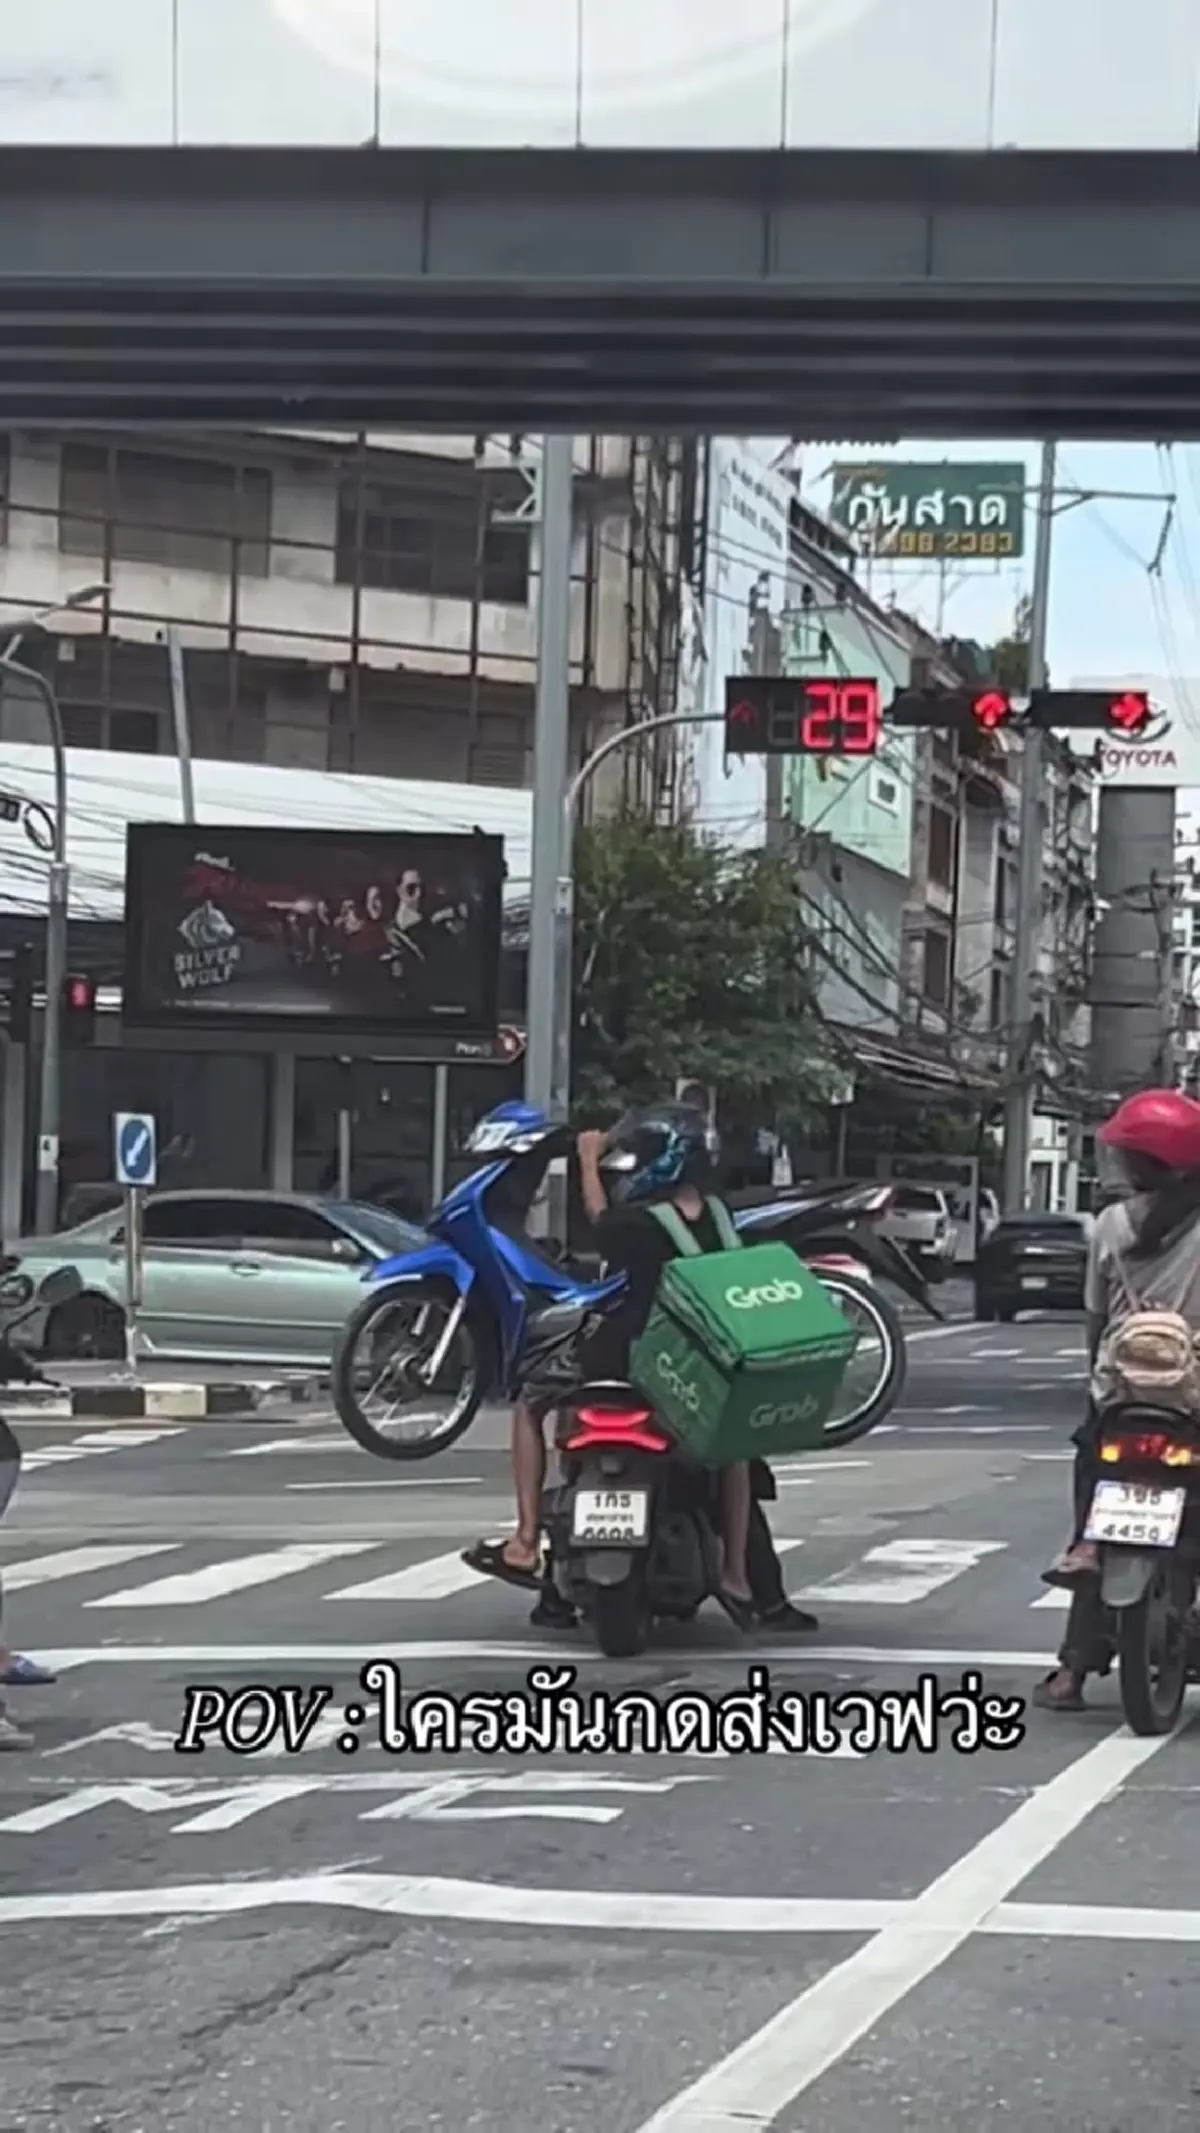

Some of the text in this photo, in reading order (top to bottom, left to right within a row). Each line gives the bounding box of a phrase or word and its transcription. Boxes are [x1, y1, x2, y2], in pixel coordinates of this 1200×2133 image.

[848, 482, 1007, 527] กันสาด
[803, 683, 877, 749] 29
[174, 945, 241, 971] SILVER
[177, 962, 234, 989] WOLF
[725, 1278, 803, 1309] Grab
[656, 1352, 699, 1411] Grab
[750, 1394, 819, 1428] Grab
